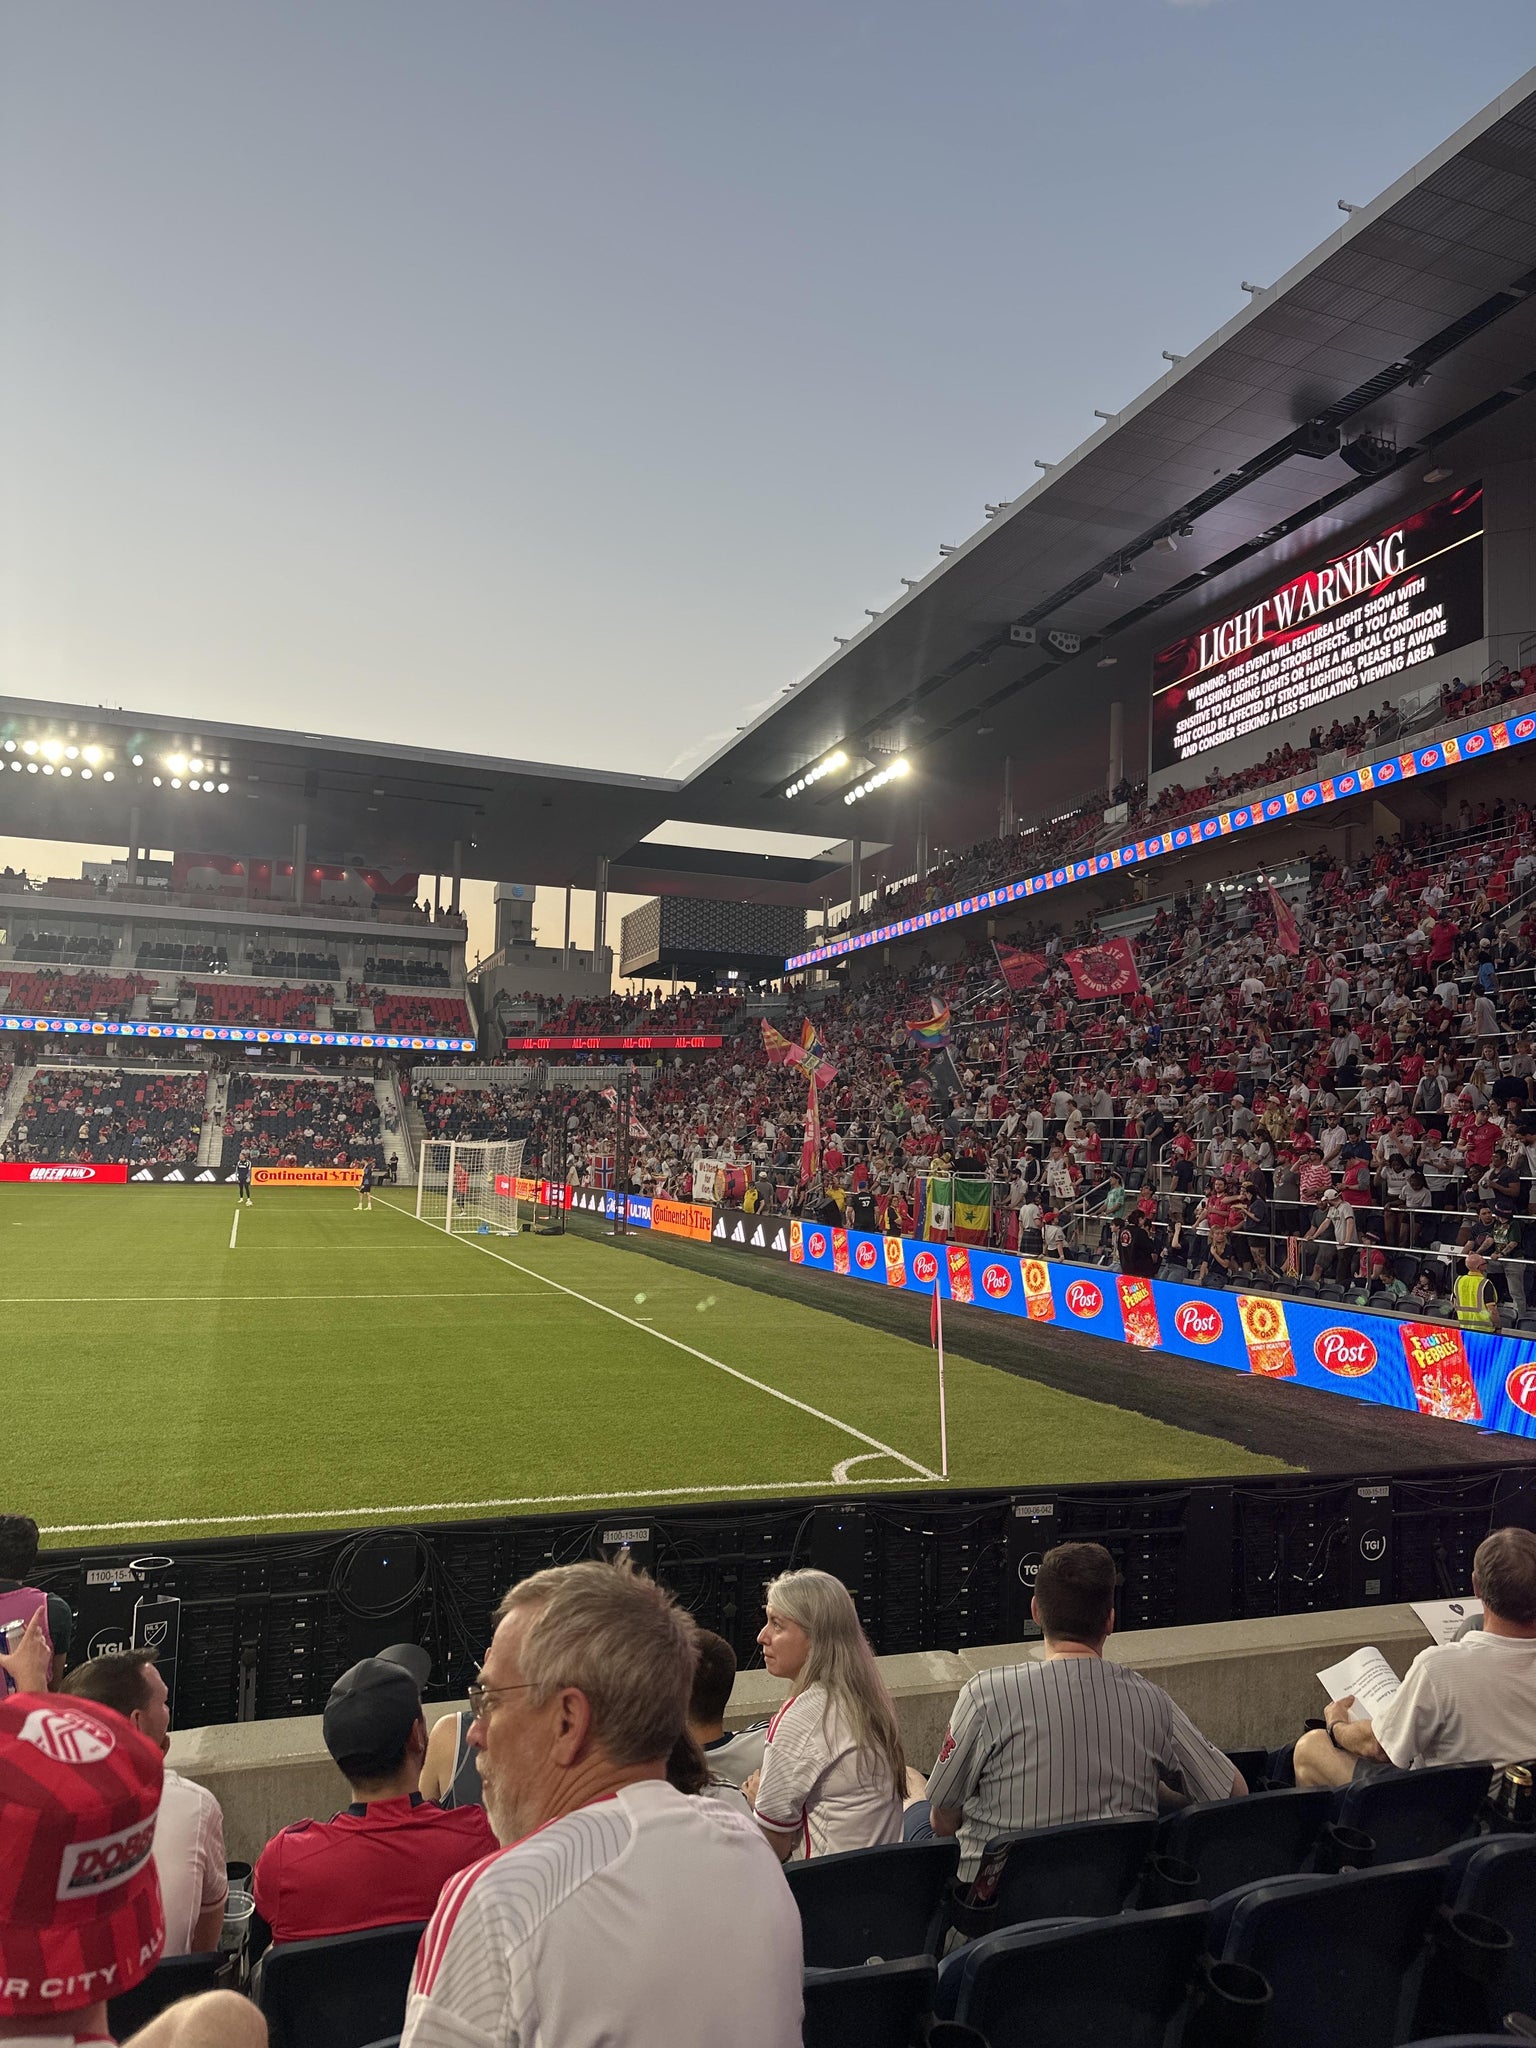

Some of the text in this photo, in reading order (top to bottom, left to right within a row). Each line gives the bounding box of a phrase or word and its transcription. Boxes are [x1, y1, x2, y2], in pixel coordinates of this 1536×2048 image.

[1200, 530, 1406, 670] LIGHT WARNING
[1187, 674, 1227, 701] WARNING:
[1227, 664, 1245, 682] THIS
[1245, 652, 1270, 673] EVENT
[1271, 642, 1291, 661] WILL
[1336, 607, 1362, 630] LIGHT
[1364, 591, 1396, 618] SHOW
[1397, 577, 1425, 602] WITH
[1196, 602, 1409, 711] FLASHING LIGHTS AND STROBE EFFECTS. IF YOU ARE
[1176, 604, 1443, 733] SENSITIVE TO FLASHING LIGHTS OR HAVE A MEDICAL CONDITION
[1173, 620, 1447, 749] THAT COULD BE AFFECTED BY STROBE LIGHTING, PLEASE BE AWARE
[1181, 643, 1434, 760] AND CONSIDER SEEKING A LESS STIMULATING VIEWING AREA
[30, 1168, 86, 1178] HOFFMANN
[254, 1170, 362, 1182] Continental Tir
[630, 1204, 651, 1220] ULTRA
[654, 1204, 710, 1230] Continental Tire
[811, 1236, 823, 1252] Post
[859, 1245, 874, 1262] Post
[917, 1256, 934, 1274] Post
[986, 1269, 1008, 1289] Post
[1071, 1286, 1098, 1308] Post
[1183, 1307, 1216, 1333] Post
[1260, 1327, 1276, 1338] OATS
[1410, 1331, 1450, 1350] FRUITY
[1323, 1334, 1370, 1364] Post
[1411, 1340, 1459, 1369] PEBBLES
[1364, 1540, 1380, 1551] TGI
[90, 1570, 143, 1581] 1100-15-1
[1024, 1564, 1040, 1576] TG
[96, 1641, 123, 1657] TGI
[40, 1963, 117, 1999] CITY
